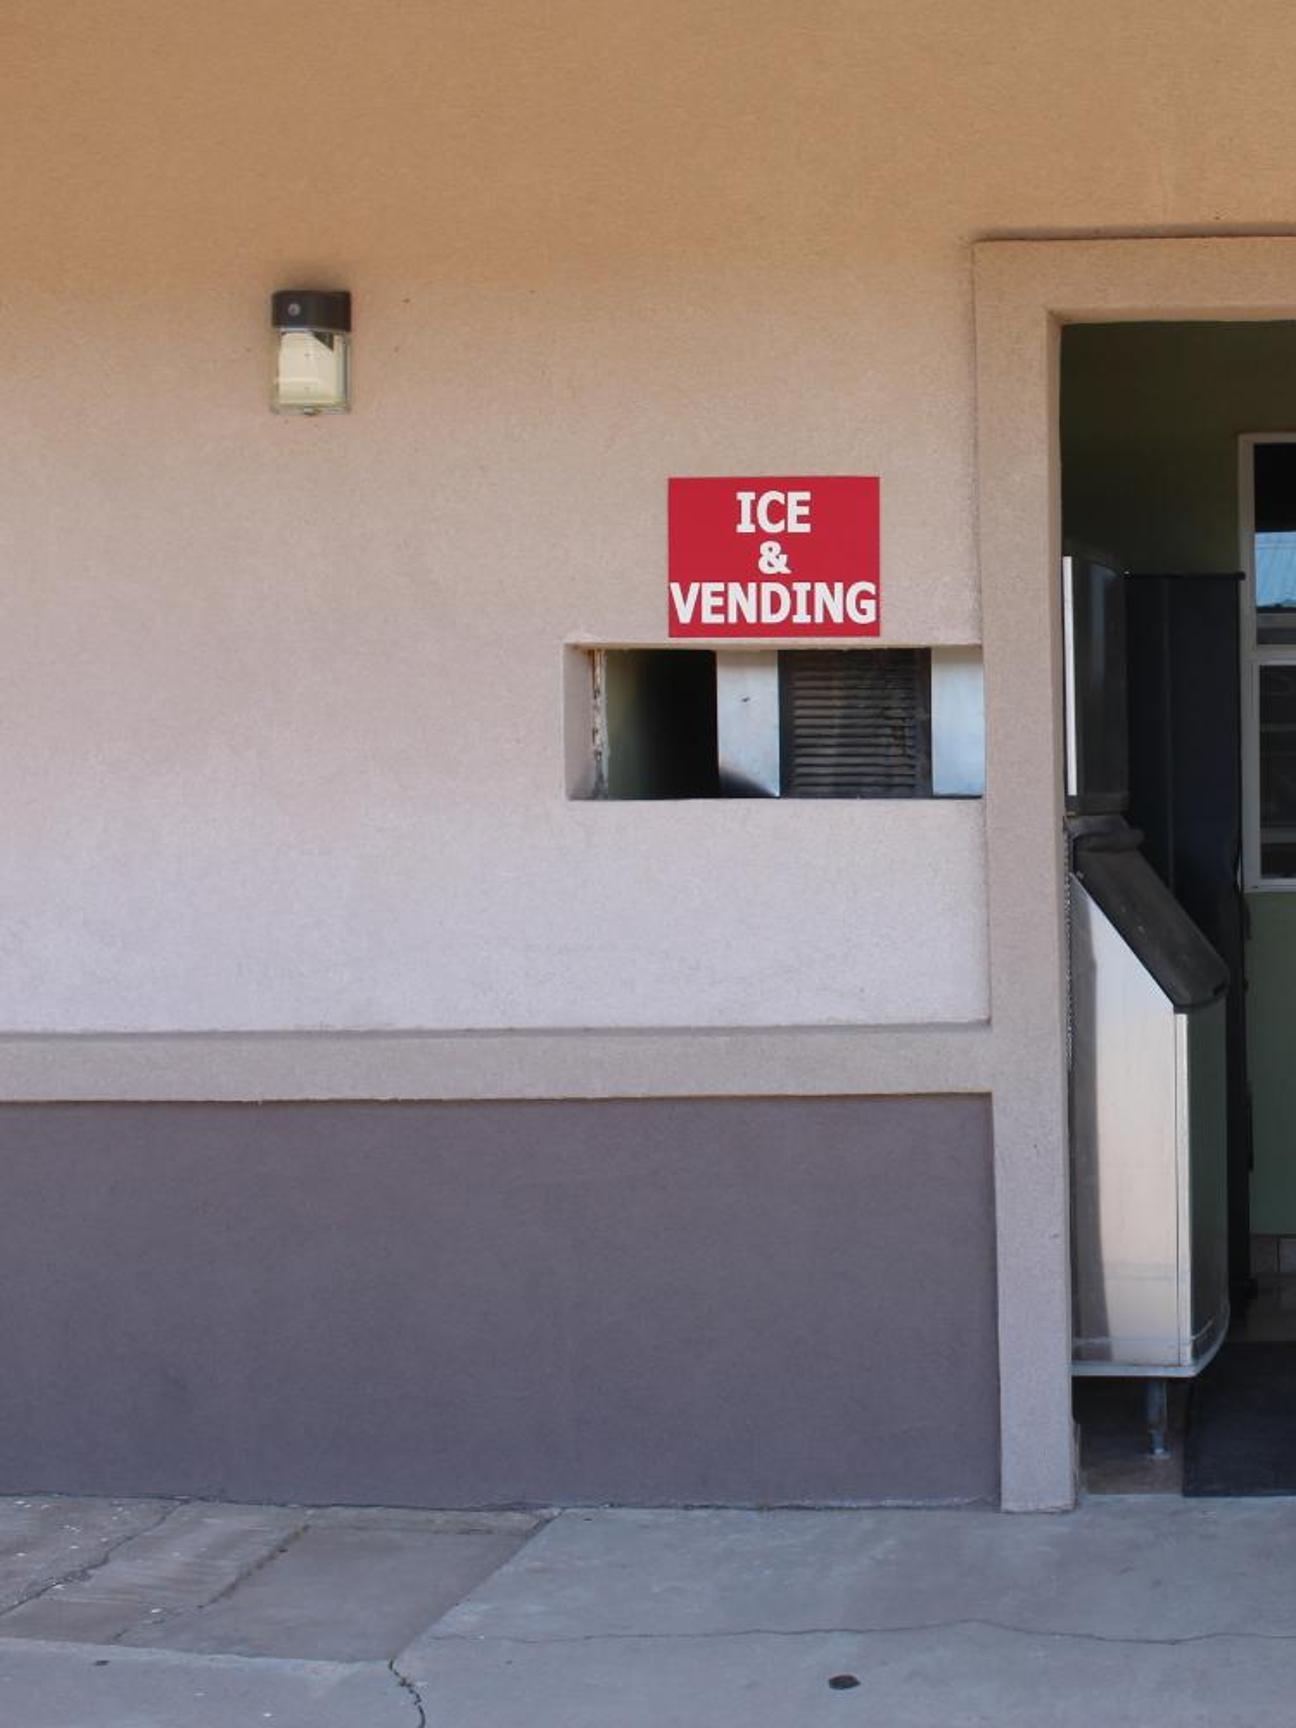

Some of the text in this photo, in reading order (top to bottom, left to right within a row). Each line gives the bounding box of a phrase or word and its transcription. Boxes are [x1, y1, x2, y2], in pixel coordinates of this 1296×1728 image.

[736, 490, 811, 533] ICE
[758, 540, 792, 574] &
[669, 581, 876, 624] VENDING
